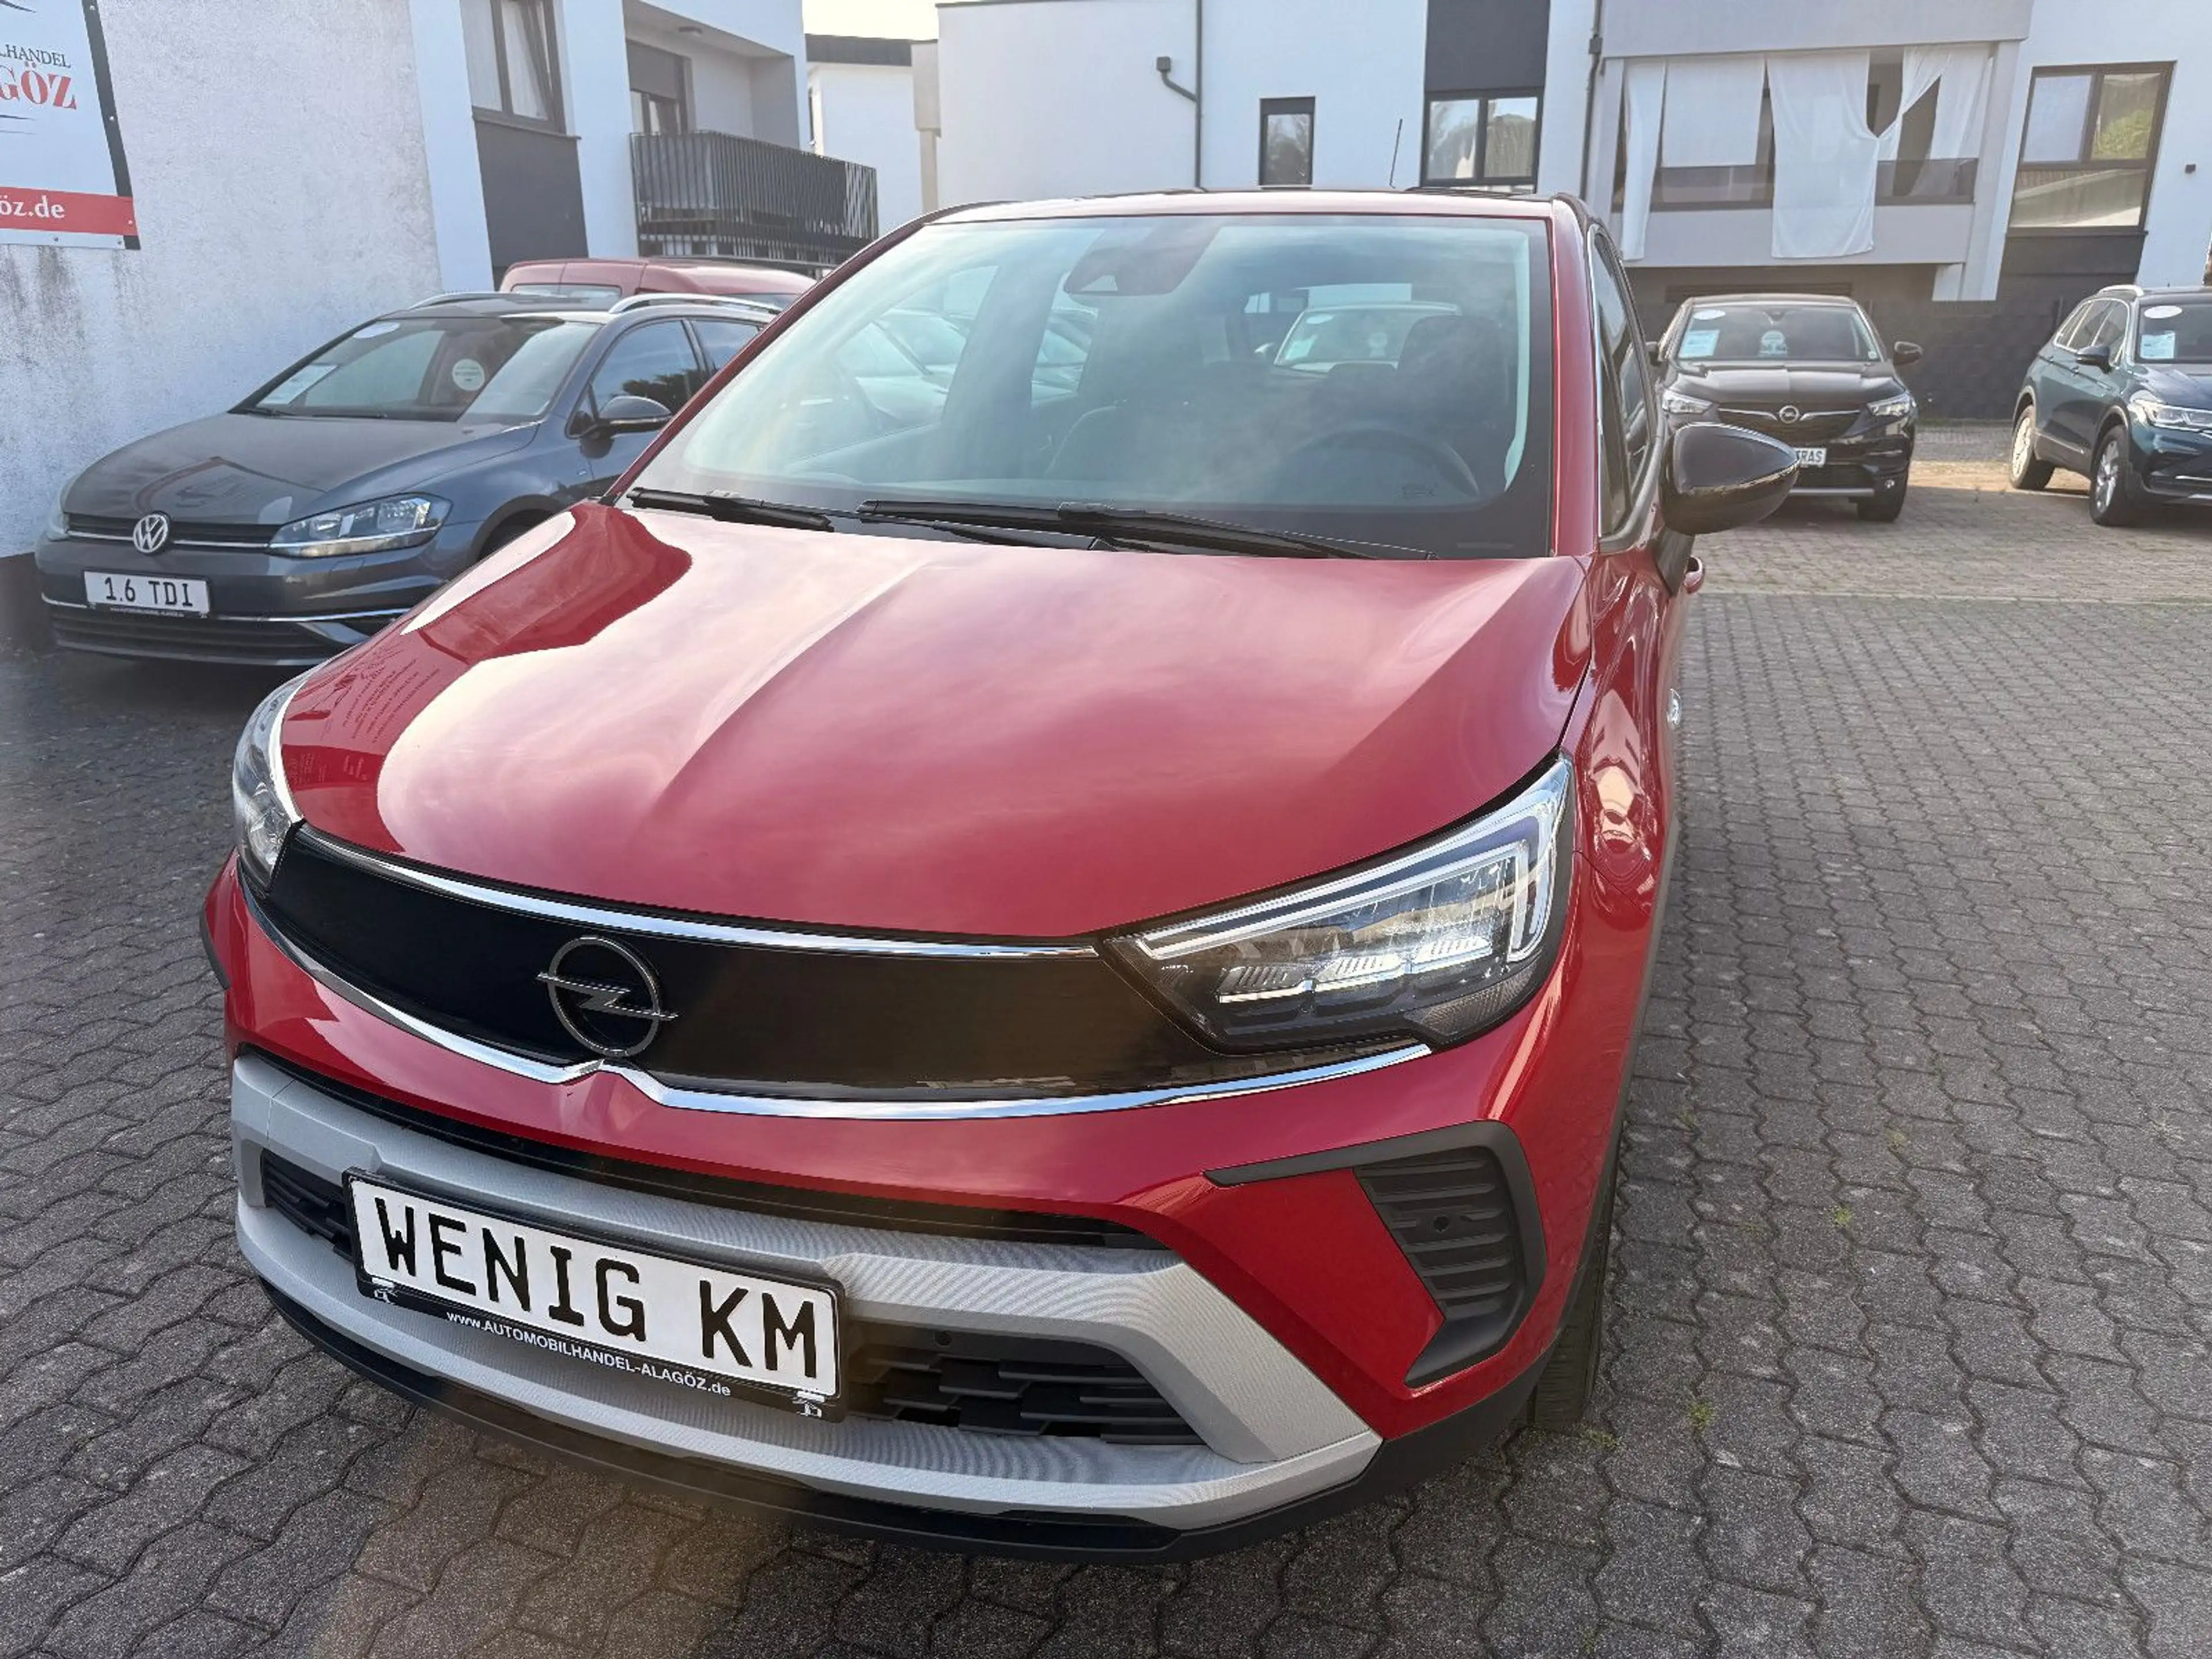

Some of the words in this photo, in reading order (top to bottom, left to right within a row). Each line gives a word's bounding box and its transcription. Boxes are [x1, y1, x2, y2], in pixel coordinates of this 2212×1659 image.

[0, 194, 65, 218] öz.de
[104, 577, 136, 602] 1.6
[148, 581, 193, 607] TDI
[374, 1197, 646, 1342] WENIG
[699, 1279, 817, 1379] KM
[446, 1312, 731, 1396] www.AUTOMOBILHANDEL-ALAGÖZ.de
